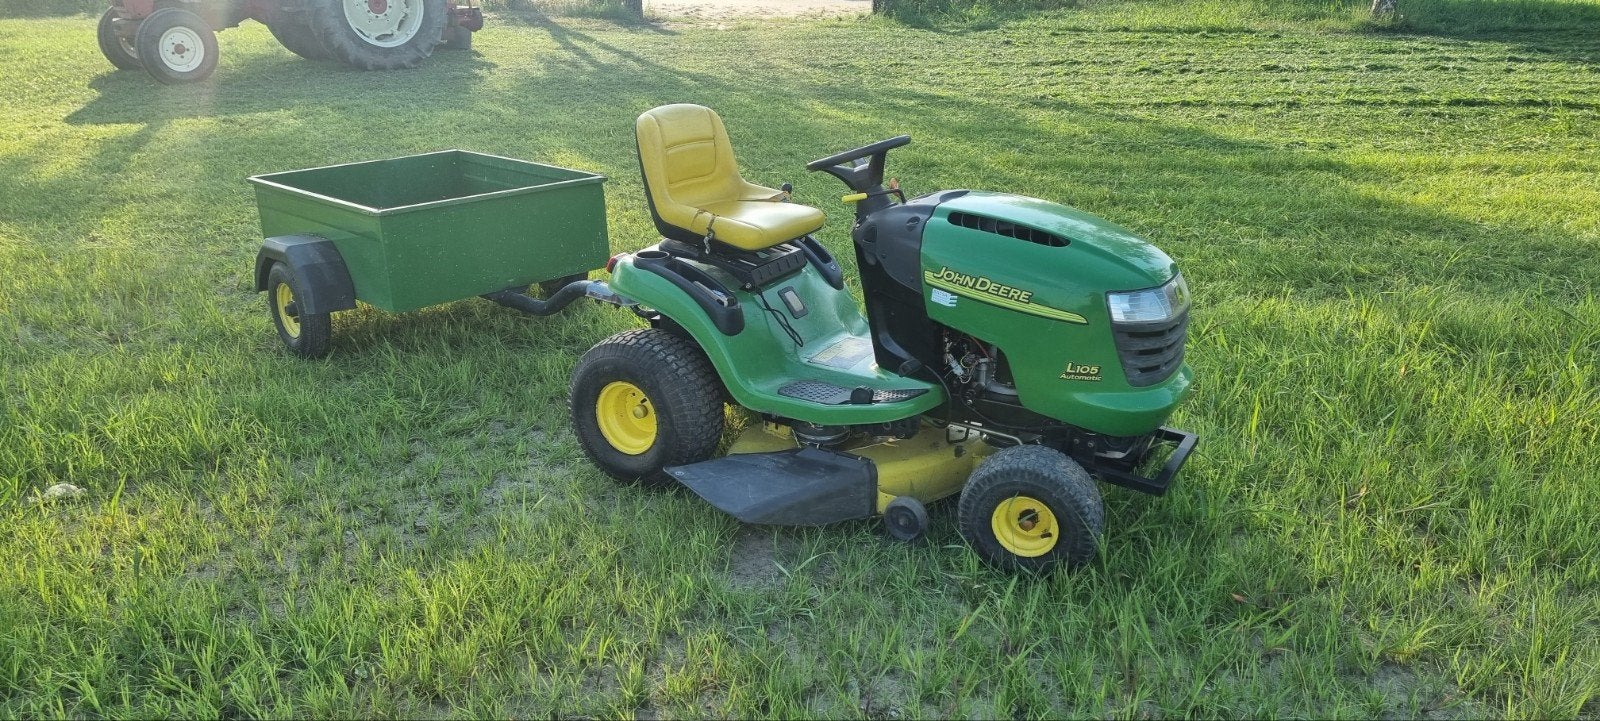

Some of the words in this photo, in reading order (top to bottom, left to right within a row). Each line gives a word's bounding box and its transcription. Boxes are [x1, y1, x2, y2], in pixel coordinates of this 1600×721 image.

[933, 266, 976, 288] JOHN
[975, 277, 1032, 303] DEERE
[1066, 362, 1100, 375] L105
[1059, 373, 1102, 381] Automatic
